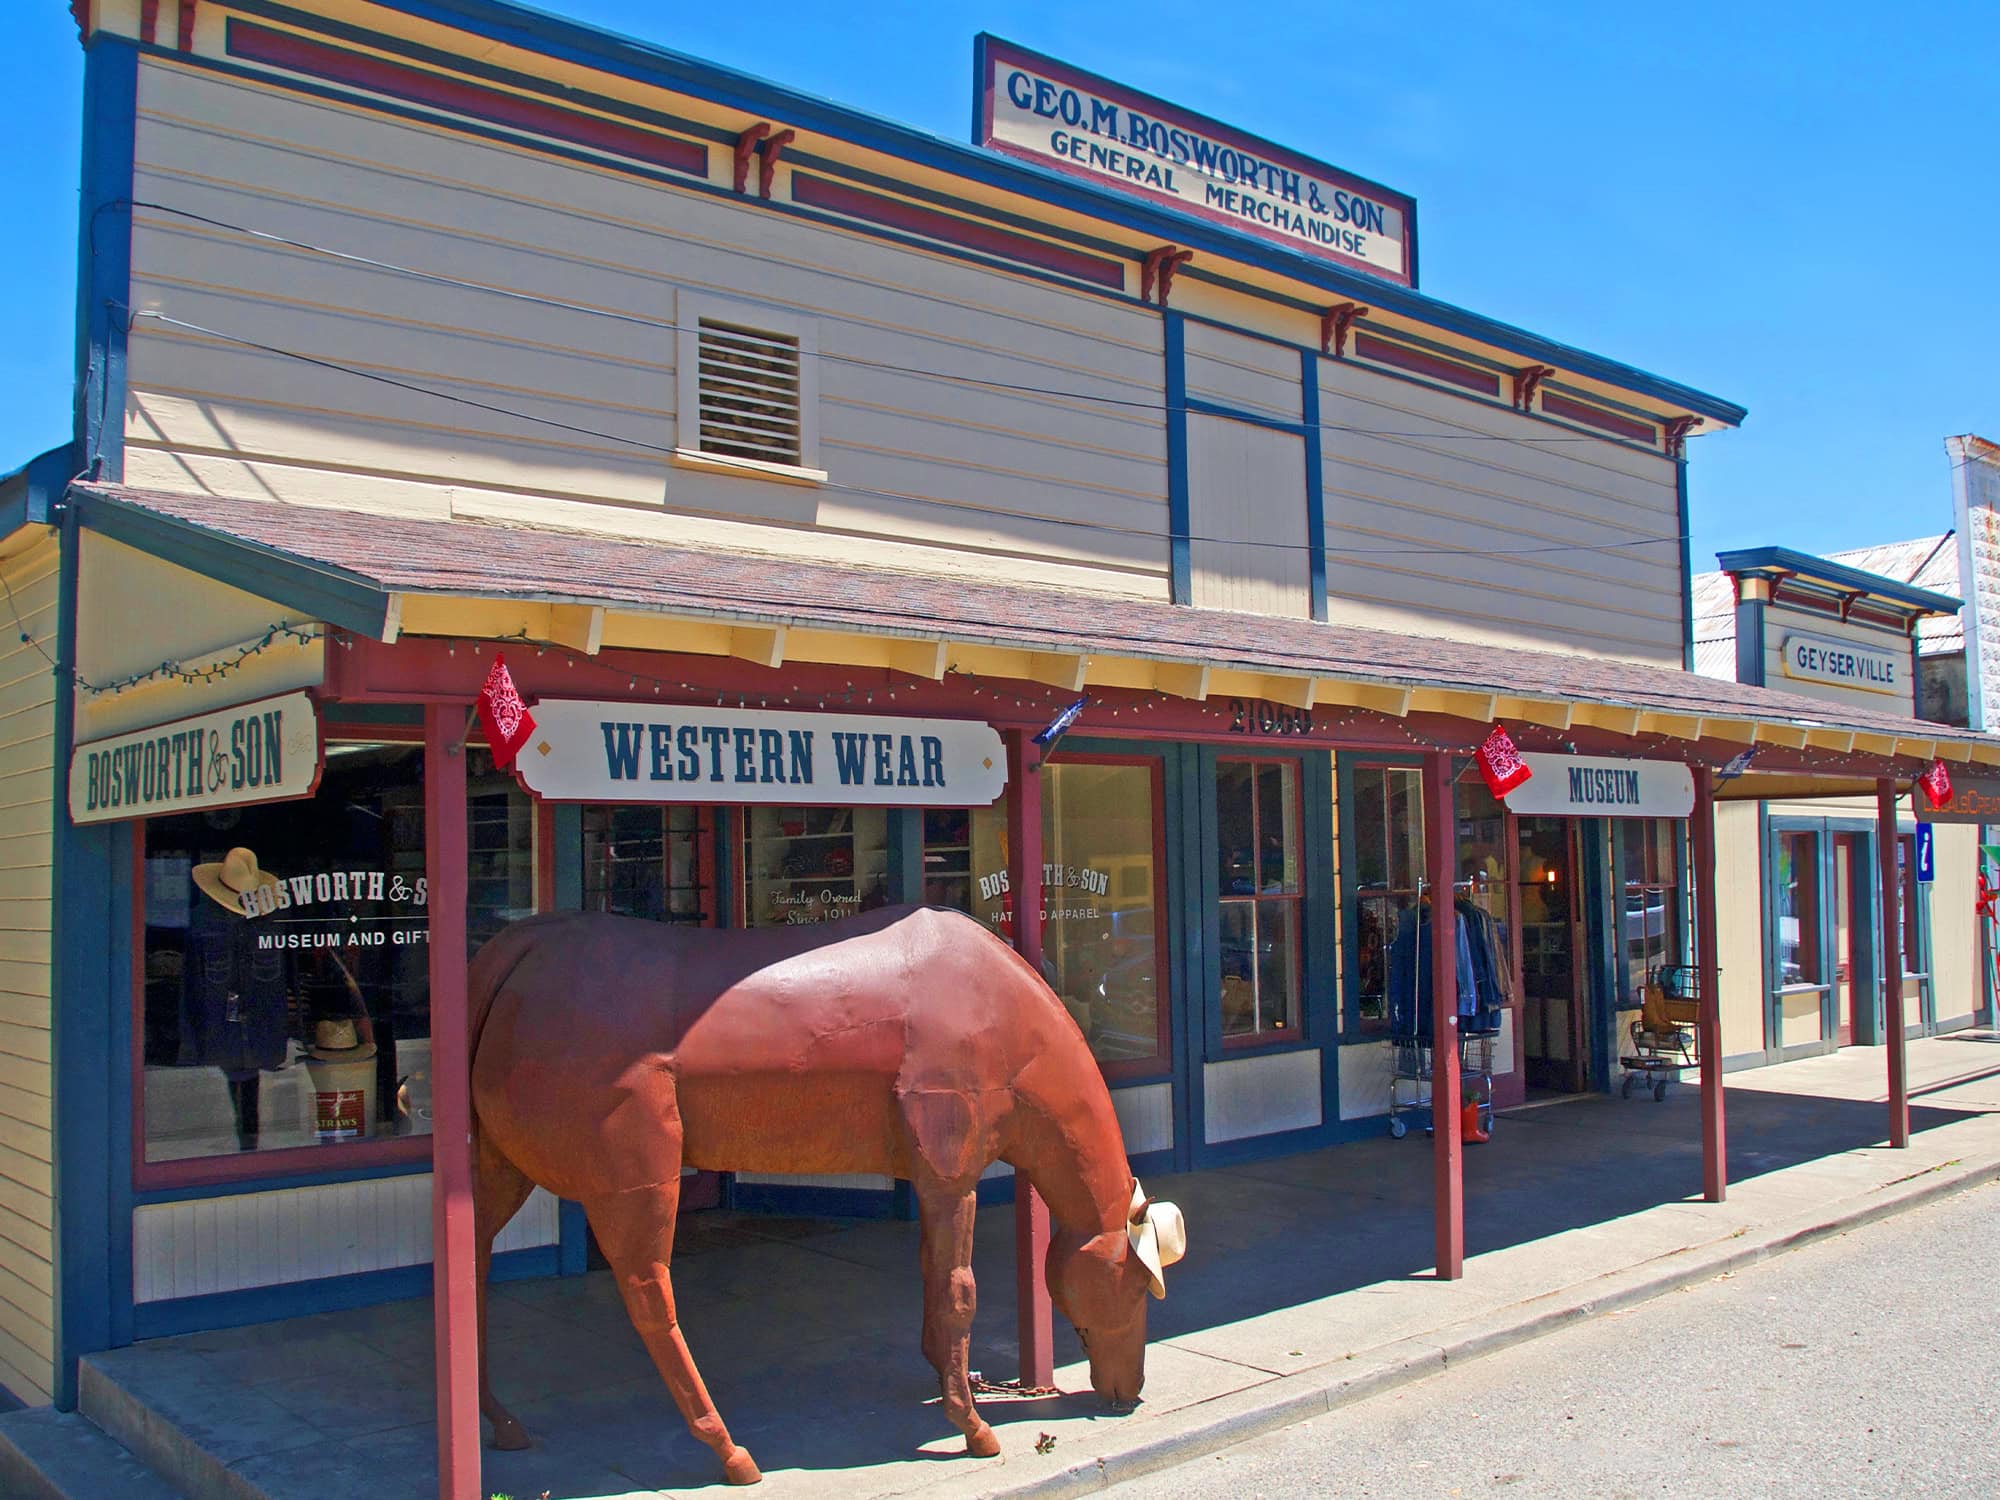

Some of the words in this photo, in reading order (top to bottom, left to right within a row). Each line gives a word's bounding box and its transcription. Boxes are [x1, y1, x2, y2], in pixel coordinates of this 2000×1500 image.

[1051, 131, 1180, 194] GENERAL
[1206, 183, 1367, 257] MERCHANDISE
[1308, 181, 1330, 216] &
[1334, 190, 1385, 237] SON
[1797, 645, 1895, 684] GEYSERVILLE
[87, 728, 205, 811] BOSWORTH
[207, 729, 230, 793] &
[231, 710, 283, 790] SON
[600, 721, 815, 785] WESTERN
[831, 731, 947, 788] WEAR
[1567, 766, 1640, 805] MUSEUM
[240, 871, 385, 919] BOSWORTH
[388, 875, 413, 902] &
[770, 889, 815, 910] Family
[820, 889, 862, 904] Owned
[1066, 866, 1081, 887] &
[1081, 868, 1109, 896] SON
[786, 909, 819, 926] Since
[1050, 908, 1100, 920] APPAREL
[258, 932, 341, 950] MUSEUM
[347, 930, 386, 947] AND
